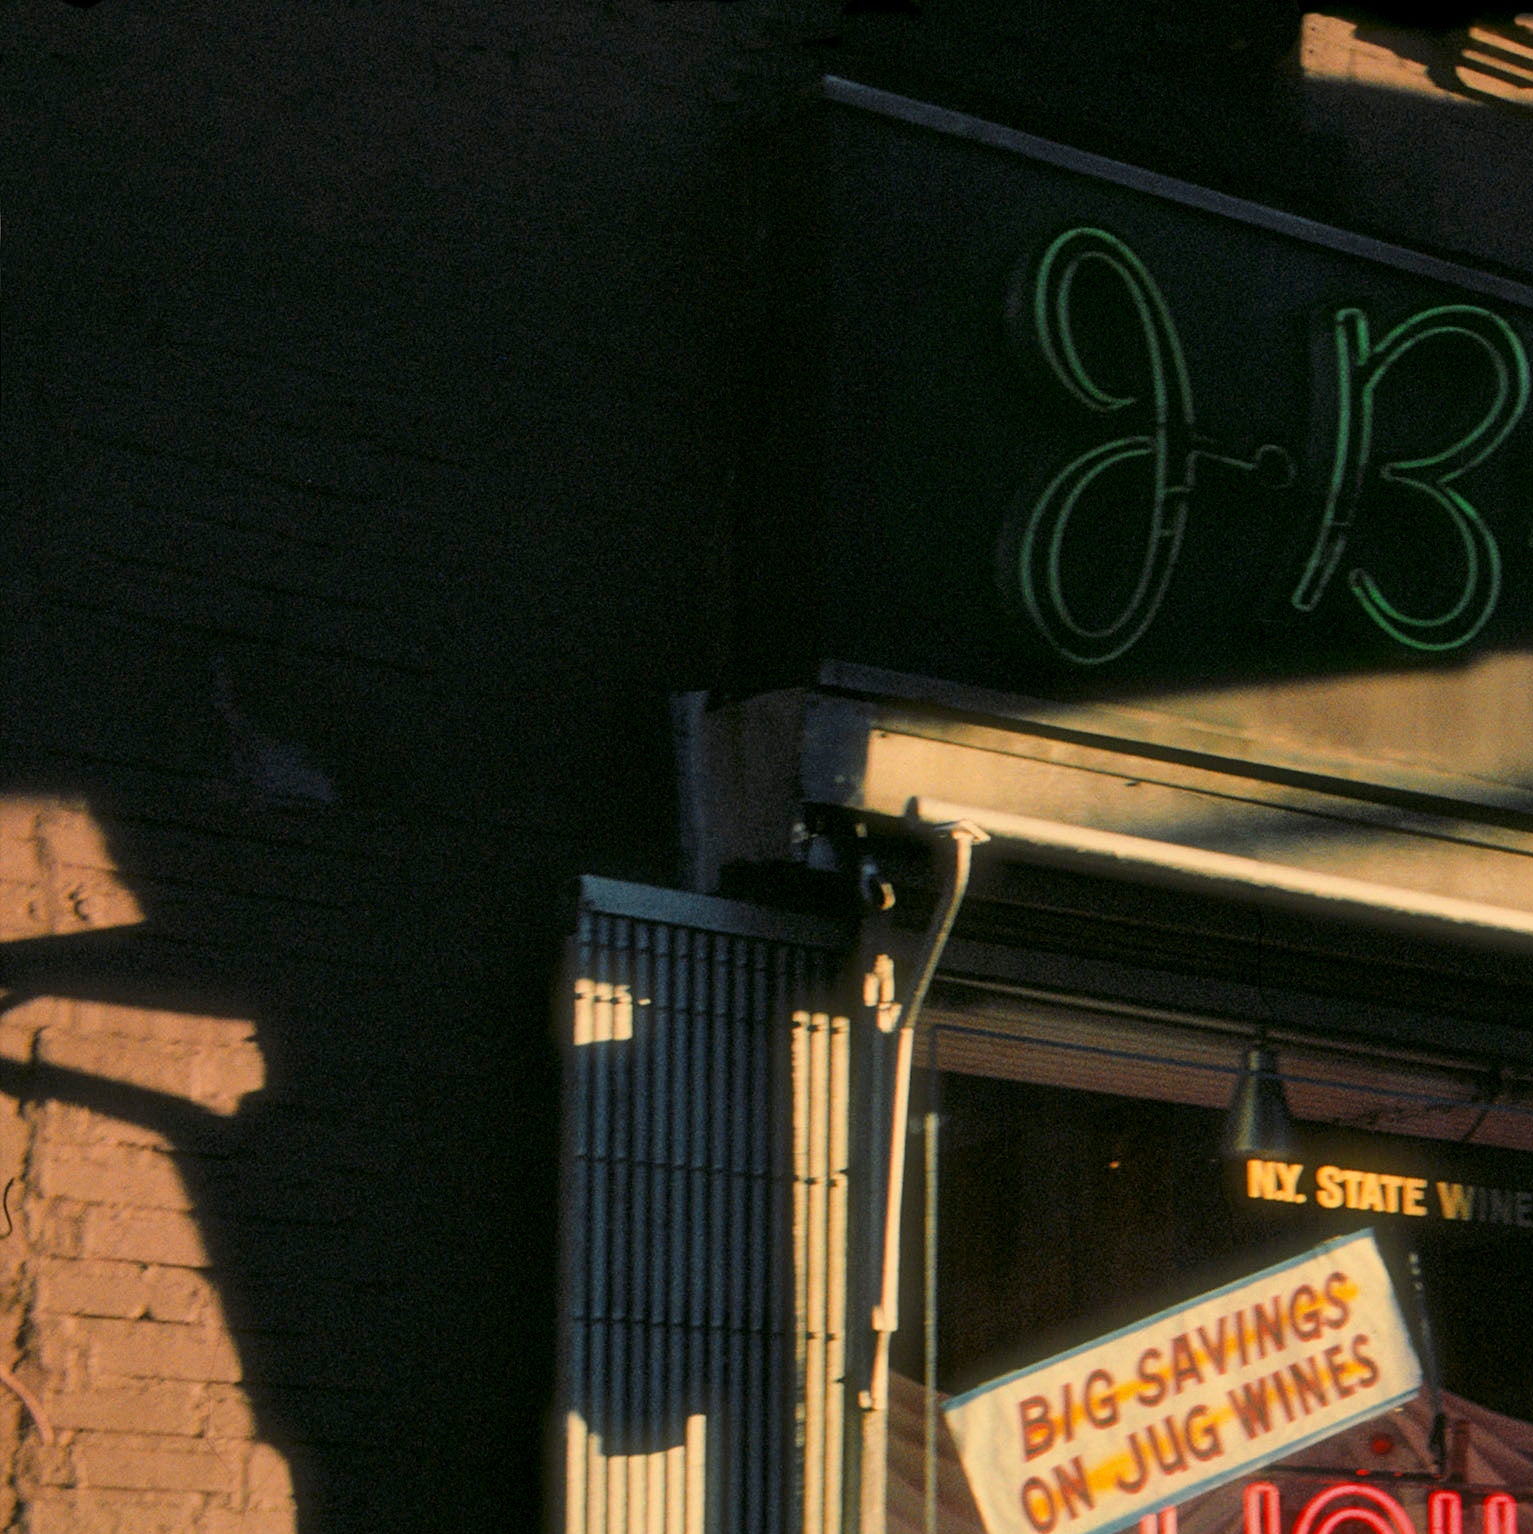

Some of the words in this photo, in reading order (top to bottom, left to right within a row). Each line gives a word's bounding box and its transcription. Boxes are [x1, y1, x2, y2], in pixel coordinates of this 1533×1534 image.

[1314, 1163, 1429, 1218] STATE
[1017, 1367, 1121, 1463] BIG
[1135, 1271, 1352, 1408] SAVINGS
[1115, 1405, 1225, 1496] JUG
[1228, 1333, 1383, 1440] WINES
